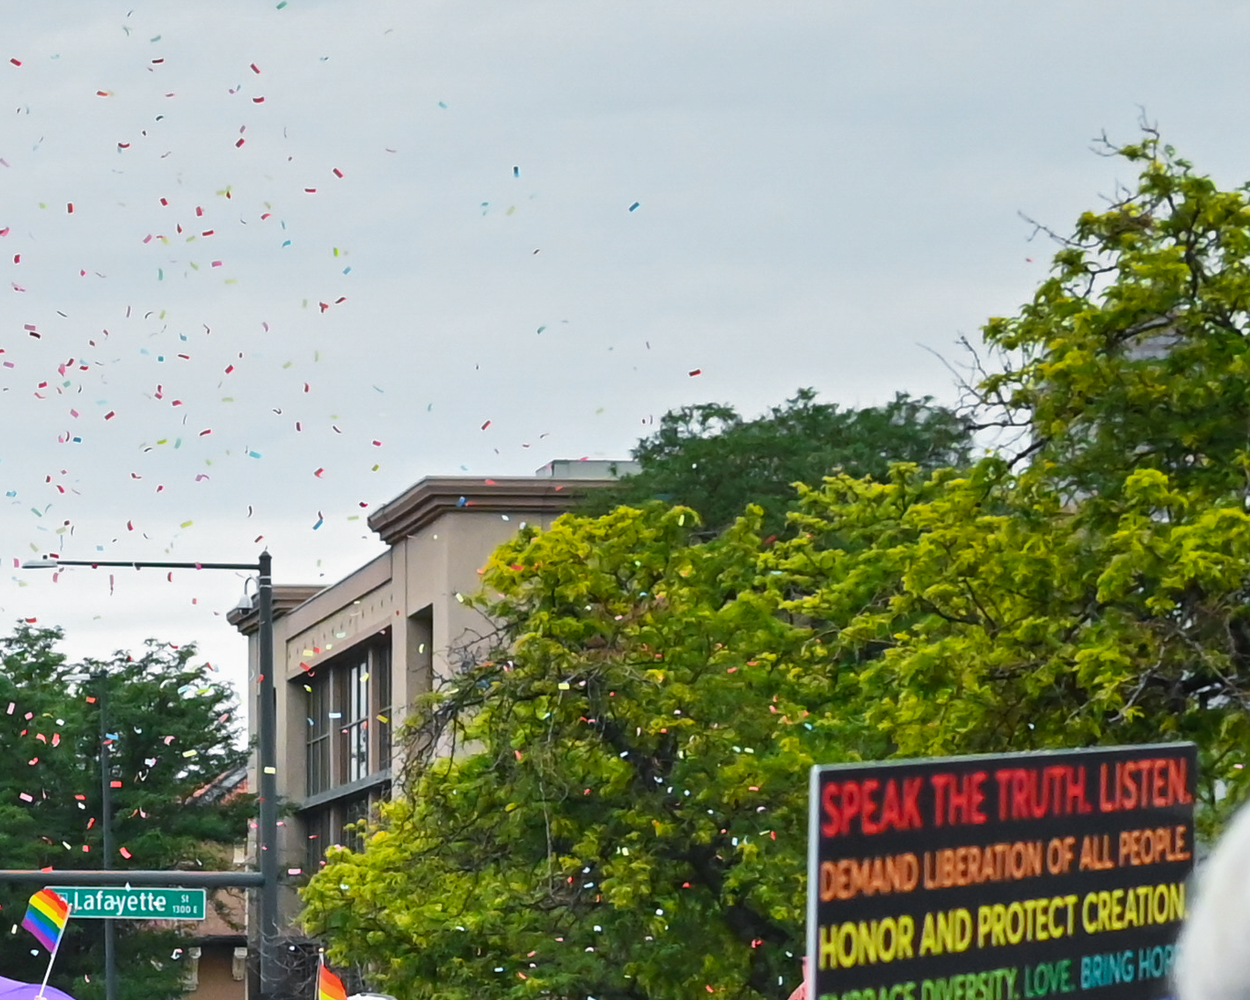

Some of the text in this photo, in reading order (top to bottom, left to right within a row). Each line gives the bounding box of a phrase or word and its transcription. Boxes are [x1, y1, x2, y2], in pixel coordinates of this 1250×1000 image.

[821, 757, 1193, 838] SPEAK THE TRUTH. LISTEN.
[820, 824, 1191, 901] DEMAND LIBERATION OF ALL PEOPLE.
[74, 891, 167, 915] Lafayette
[172, 905, 190, 914] 1300
[819, 914, 914, 970] HONOR
[919, 909, 972, 957] AND
[978, 894, 1078, 948] PROTECT
[1023, 959, 1076, 996] LOVE.
[1080, 950, 1135, 990] BRING
[1138, 944, 1178, 980] HOP
